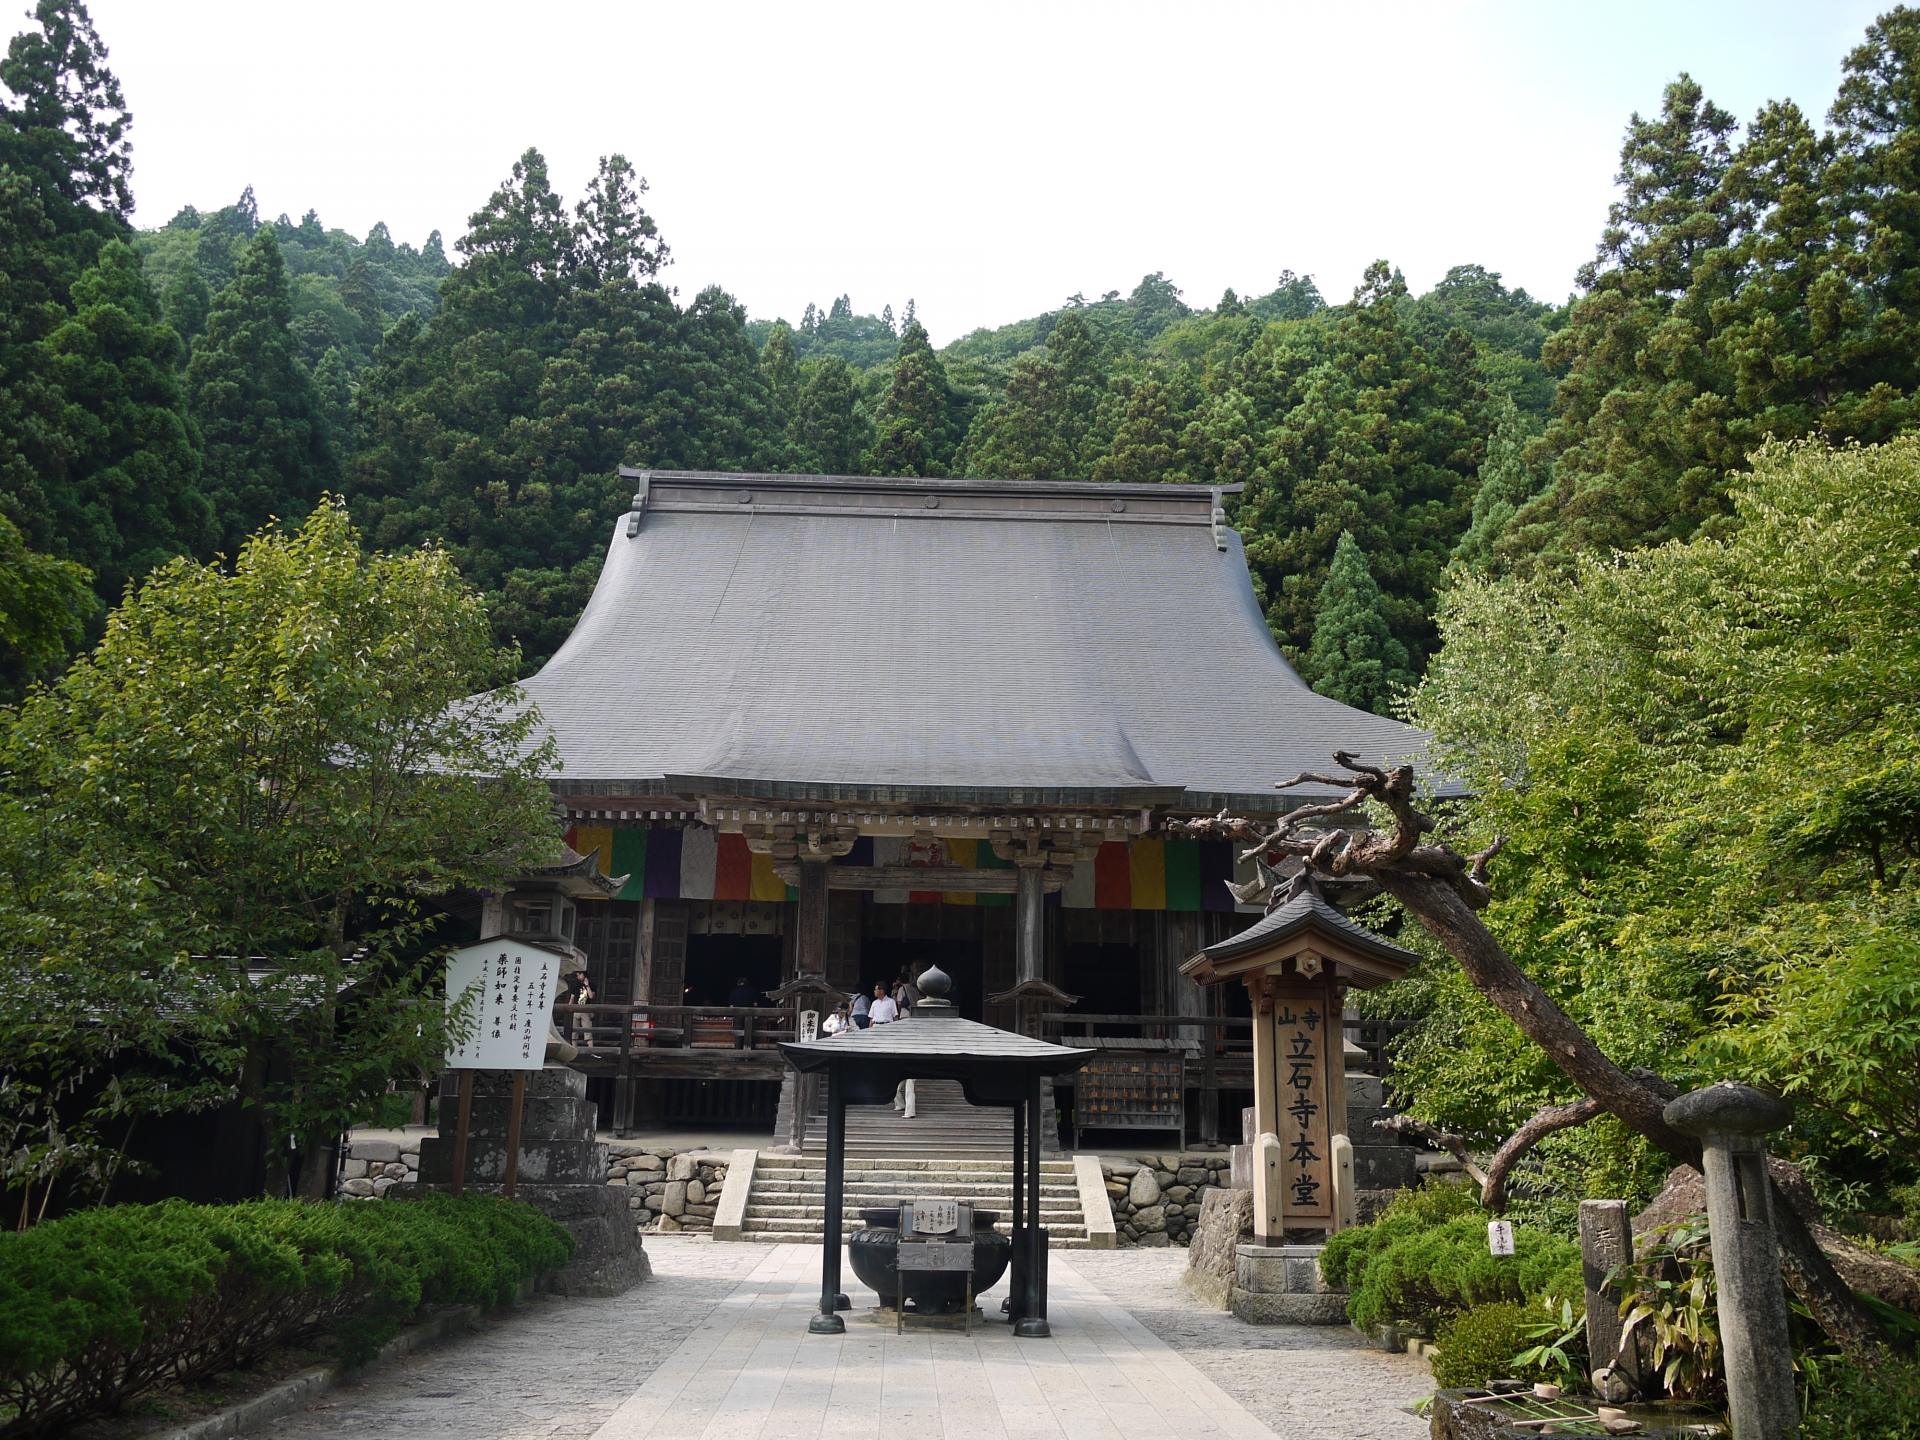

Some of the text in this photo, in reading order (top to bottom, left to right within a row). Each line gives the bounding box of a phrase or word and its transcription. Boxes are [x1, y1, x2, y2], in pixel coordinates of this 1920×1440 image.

[537, 962, 549, 1010] 立石寺本尊
[522, 981, 535, 1059] 五十年一度の御開帳
[1277, 1006, 1321, 1031] 山寺
[1286, 1031, 1321, 1207] 立石寺本堂
